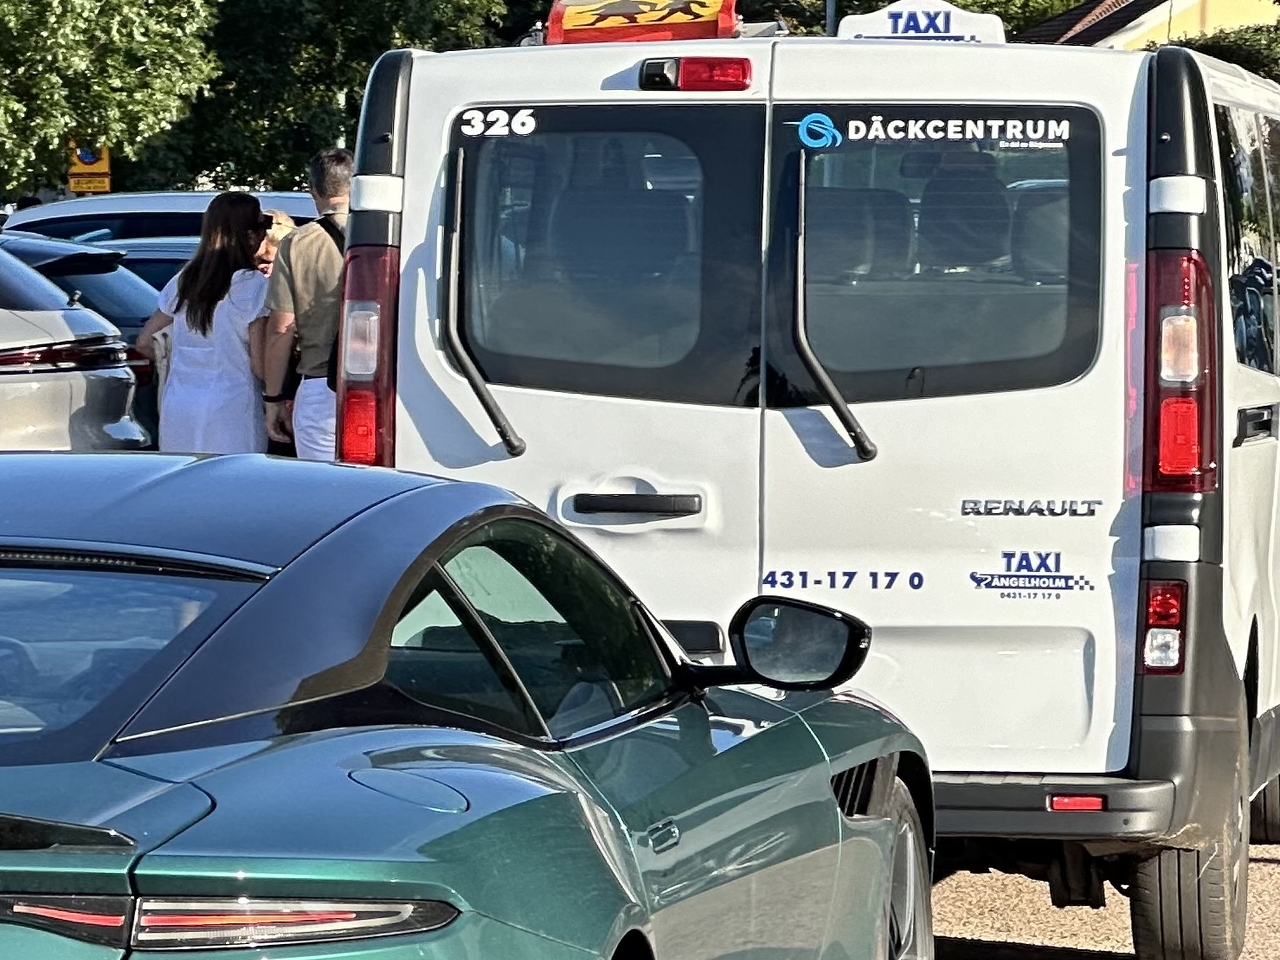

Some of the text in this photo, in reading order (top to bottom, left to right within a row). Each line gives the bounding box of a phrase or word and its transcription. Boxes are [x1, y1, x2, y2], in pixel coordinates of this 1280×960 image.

[887, 10, 952, 34] TAXI
[461, 109, 536, 136] 326
[848, 115, 1070, 140] DÄCKCENTRUM
[961, 499, 1103, 517] RENAULT
[1001, 550, 1061, 573] TAXI
[762, 571, 924, 590] 431-17 17 0
[992, 576, 1066, 588] ÄNGELHOLM
[1042, 592, 1053, 600] 17
